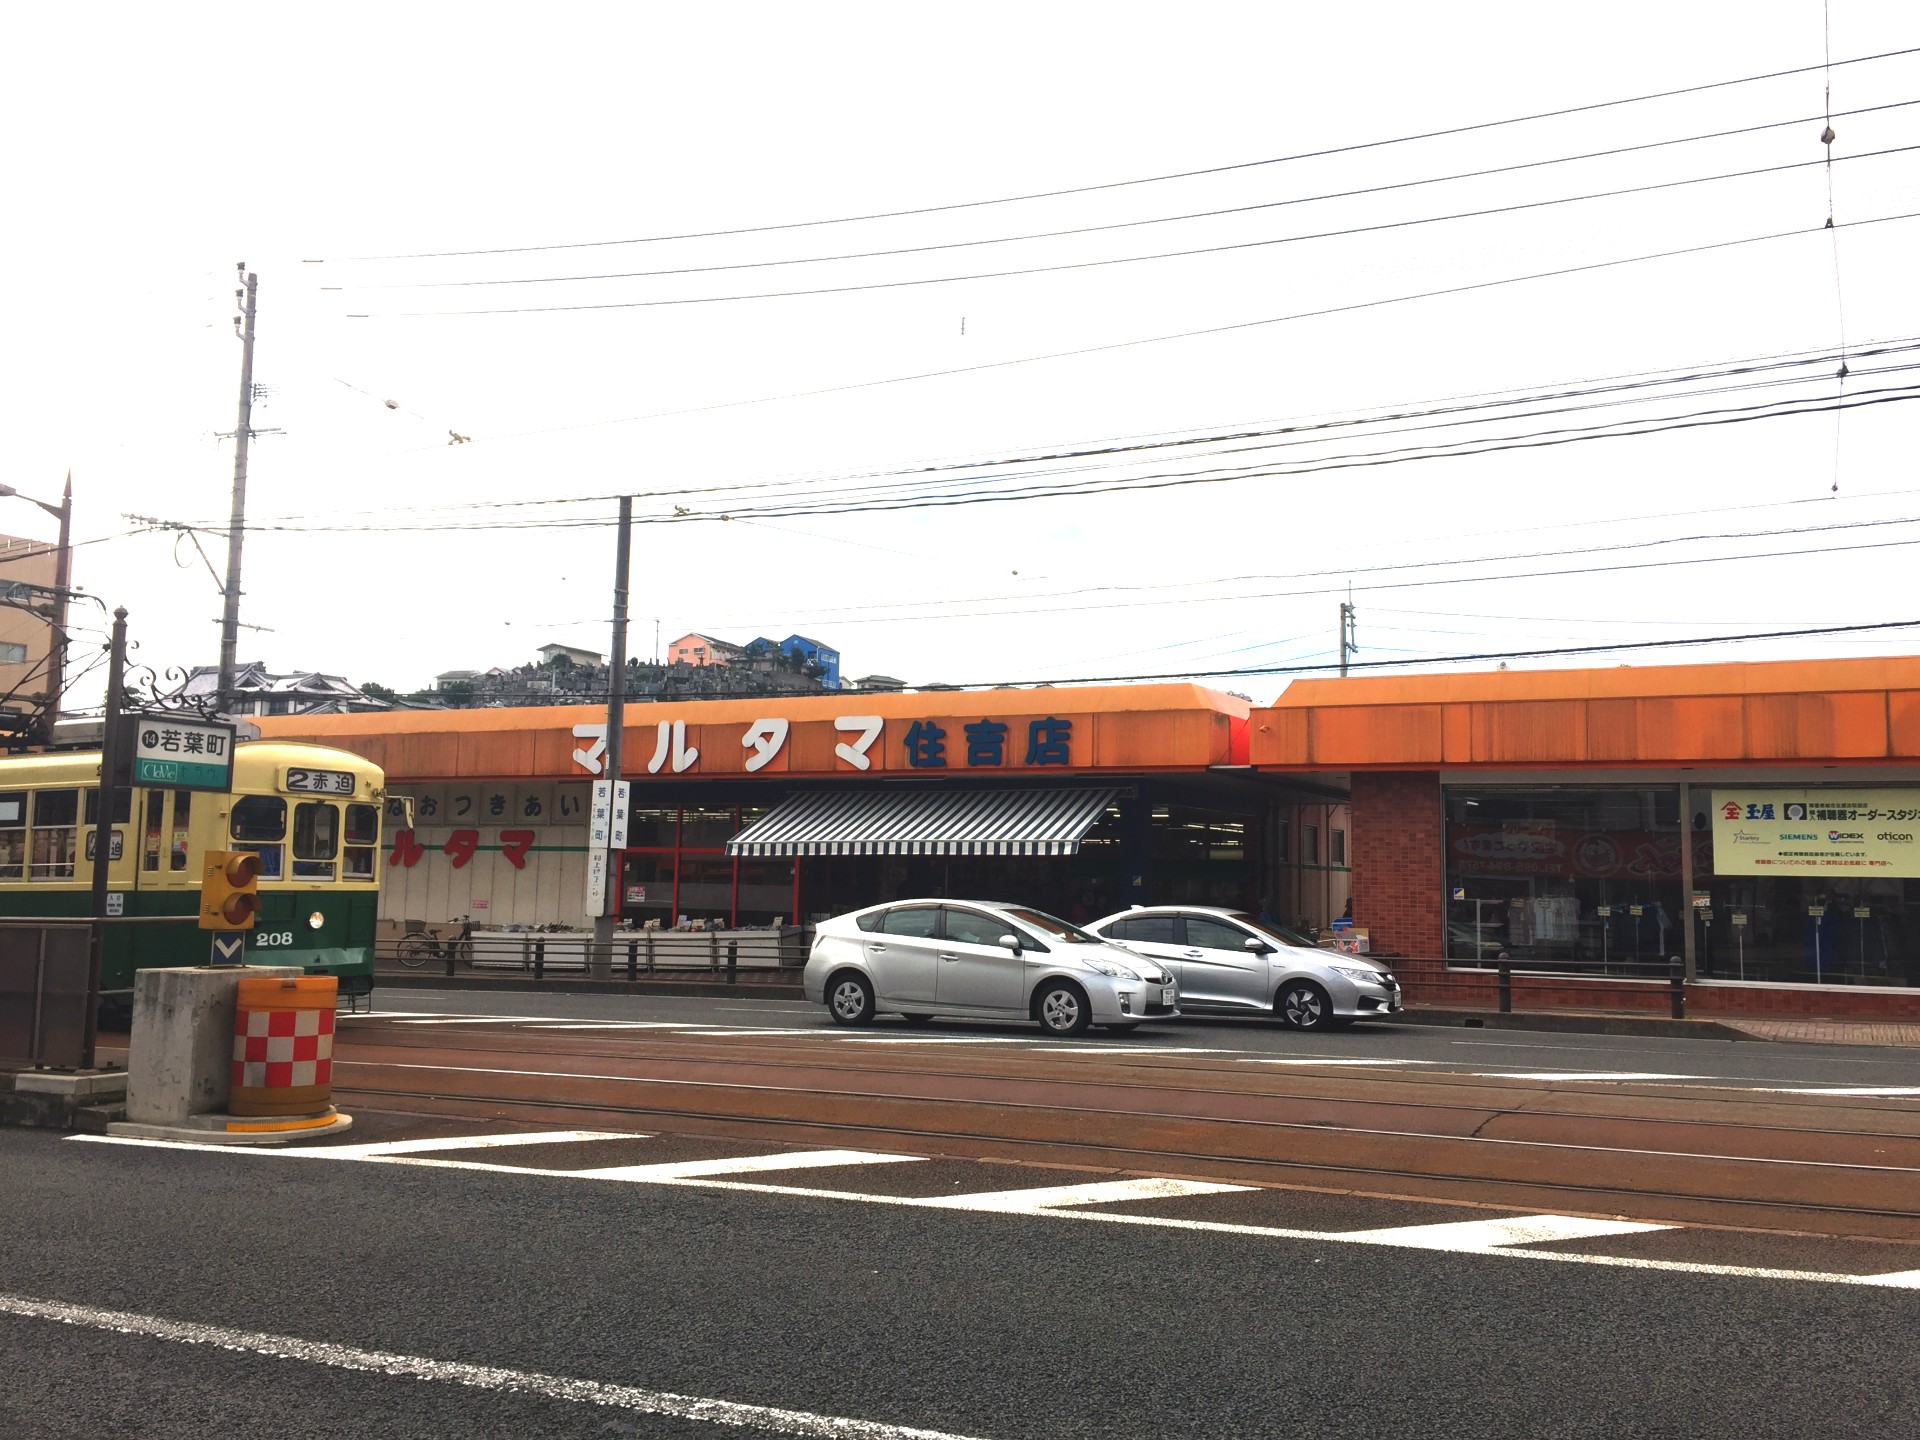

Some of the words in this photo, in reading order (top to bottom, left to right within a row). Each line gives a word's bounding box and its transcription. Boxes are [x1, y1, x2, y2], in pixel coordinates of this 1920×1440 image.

[160, 729, 227, 756] 若葉町
[572, 715, 884, 775] マルタマ
[903, 716, 1072, 768] 住吉店
[595, 786, 607, 841] 若葉町
[614, 787, 626, 842] 若葉町
[1745, 803, 1776, 820] 玉屋
[1816, 808, 1920, 821] 補聴器オーダースタジ
[1779, 833, 1818, 841] SIEMENS
[1828, 830, 1864, 841] WIDEX
[1877, 831, 1914, 841] oticon
[256, 931, 293, 946] 208
